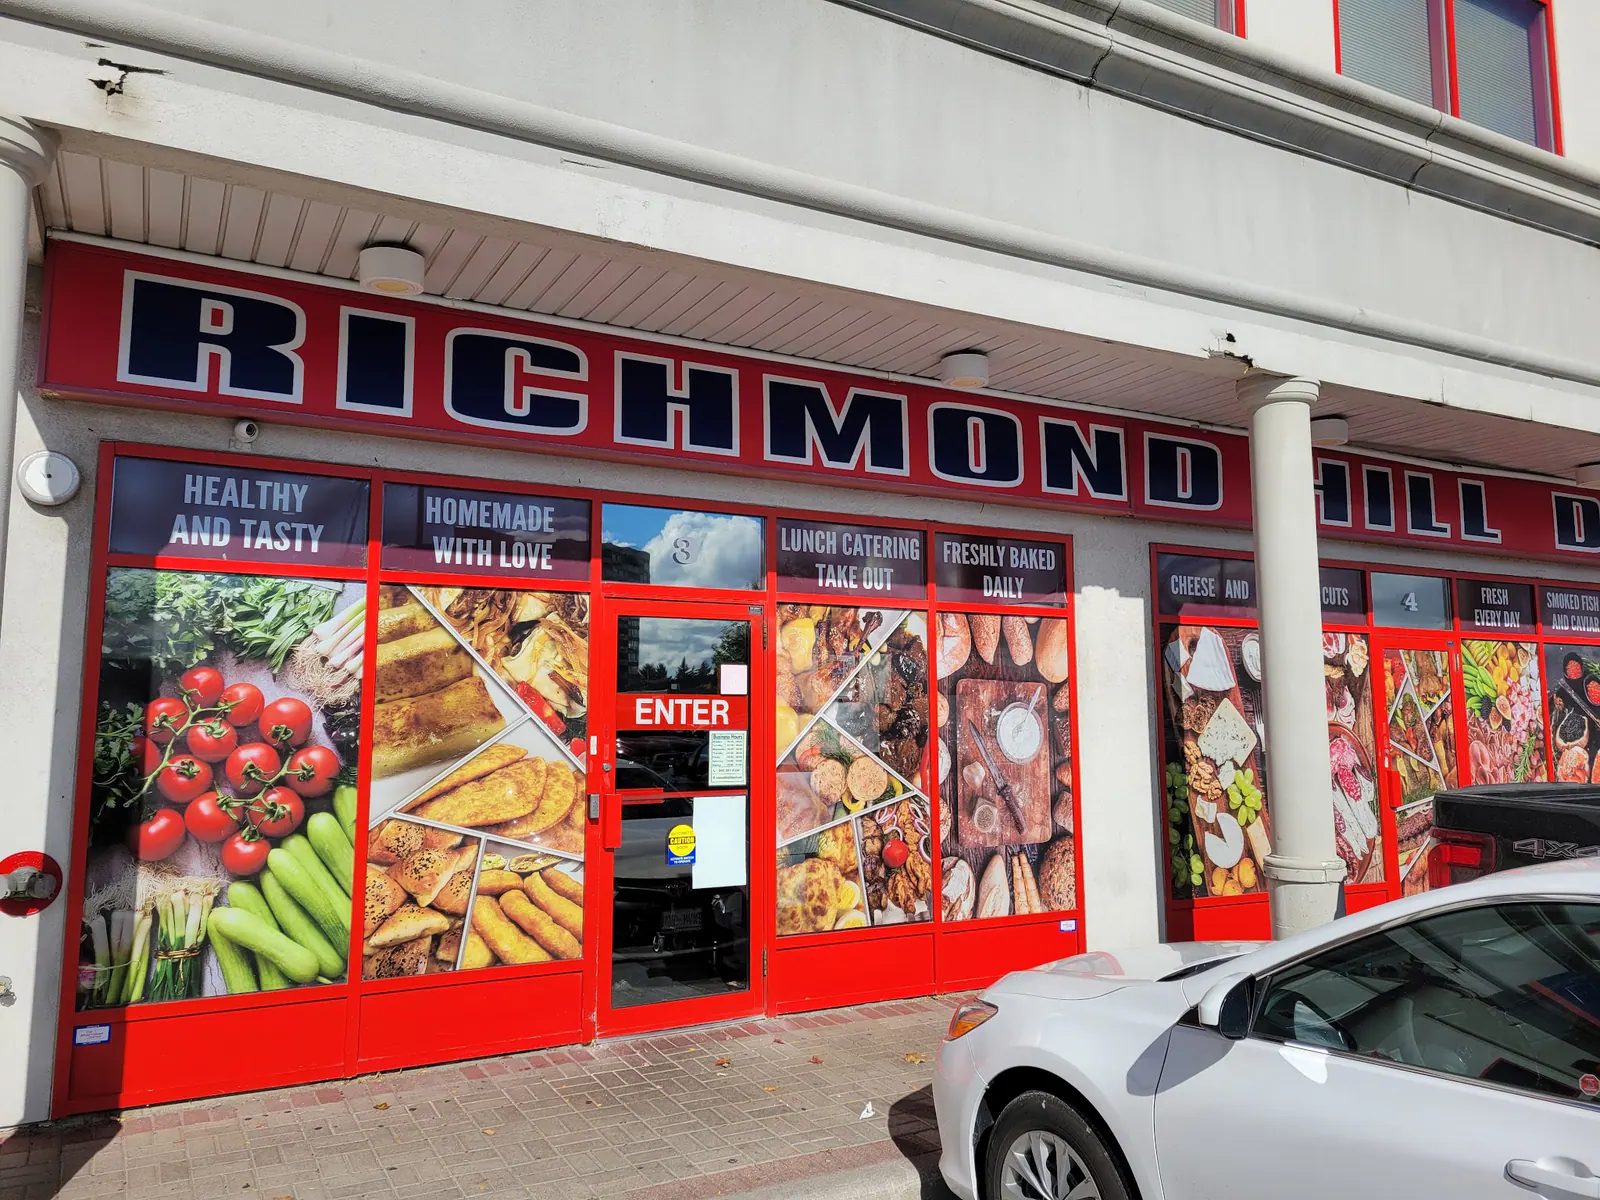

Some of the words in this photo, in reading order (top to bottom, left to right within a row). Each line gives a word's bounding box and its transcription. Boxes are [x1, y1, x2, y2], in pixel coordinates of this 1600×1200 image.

[117, 269, 1224, 511] RICHMOND
[184, 473, 309, 513] HEALTHY
[425, 496, 556, 533] HOMEMADE
[169, 514, 231, 548] AND
[240, 517, 324, 553] TASTY
[781, 527, 838, 556] LUNCH
[842, 532, 921, 561] CATERING
[432, 535, 492, 567] WITH
[500, 537, 553, 571] LOVE
[672, 536, 695, 565] 3
[942, 541, 1006, 568] FRESHLY
[1010, 545, 1056, 571] BAKED
[815, 562, 858, 590] TAKE
[863, 566, 895, 592] OUT
[983, 573, 1025, 599] DAILY
[1170, 574, 1216, 598] CHEESE
[1225, 579, 1249, 600] AND
[1322, 586, 1349, 606] CUTS
[1404, 592, 1418, 612] 4
[1481, 587, 1509, 606] FRESH
[1546, 592, 1580, 611] SMOKED
[1581, 594, 1600, 612] FISH
[1474, 609, 1501, 627] EVERY
[1503, 611, 1521, 628] DAY
[1552, 614, 1570, 630] AND
[1571, 616, 1600, 632] CAVIAR
[635, 698, 730, 726] ENTER
[670, 836, 694, 844] CAUTION
